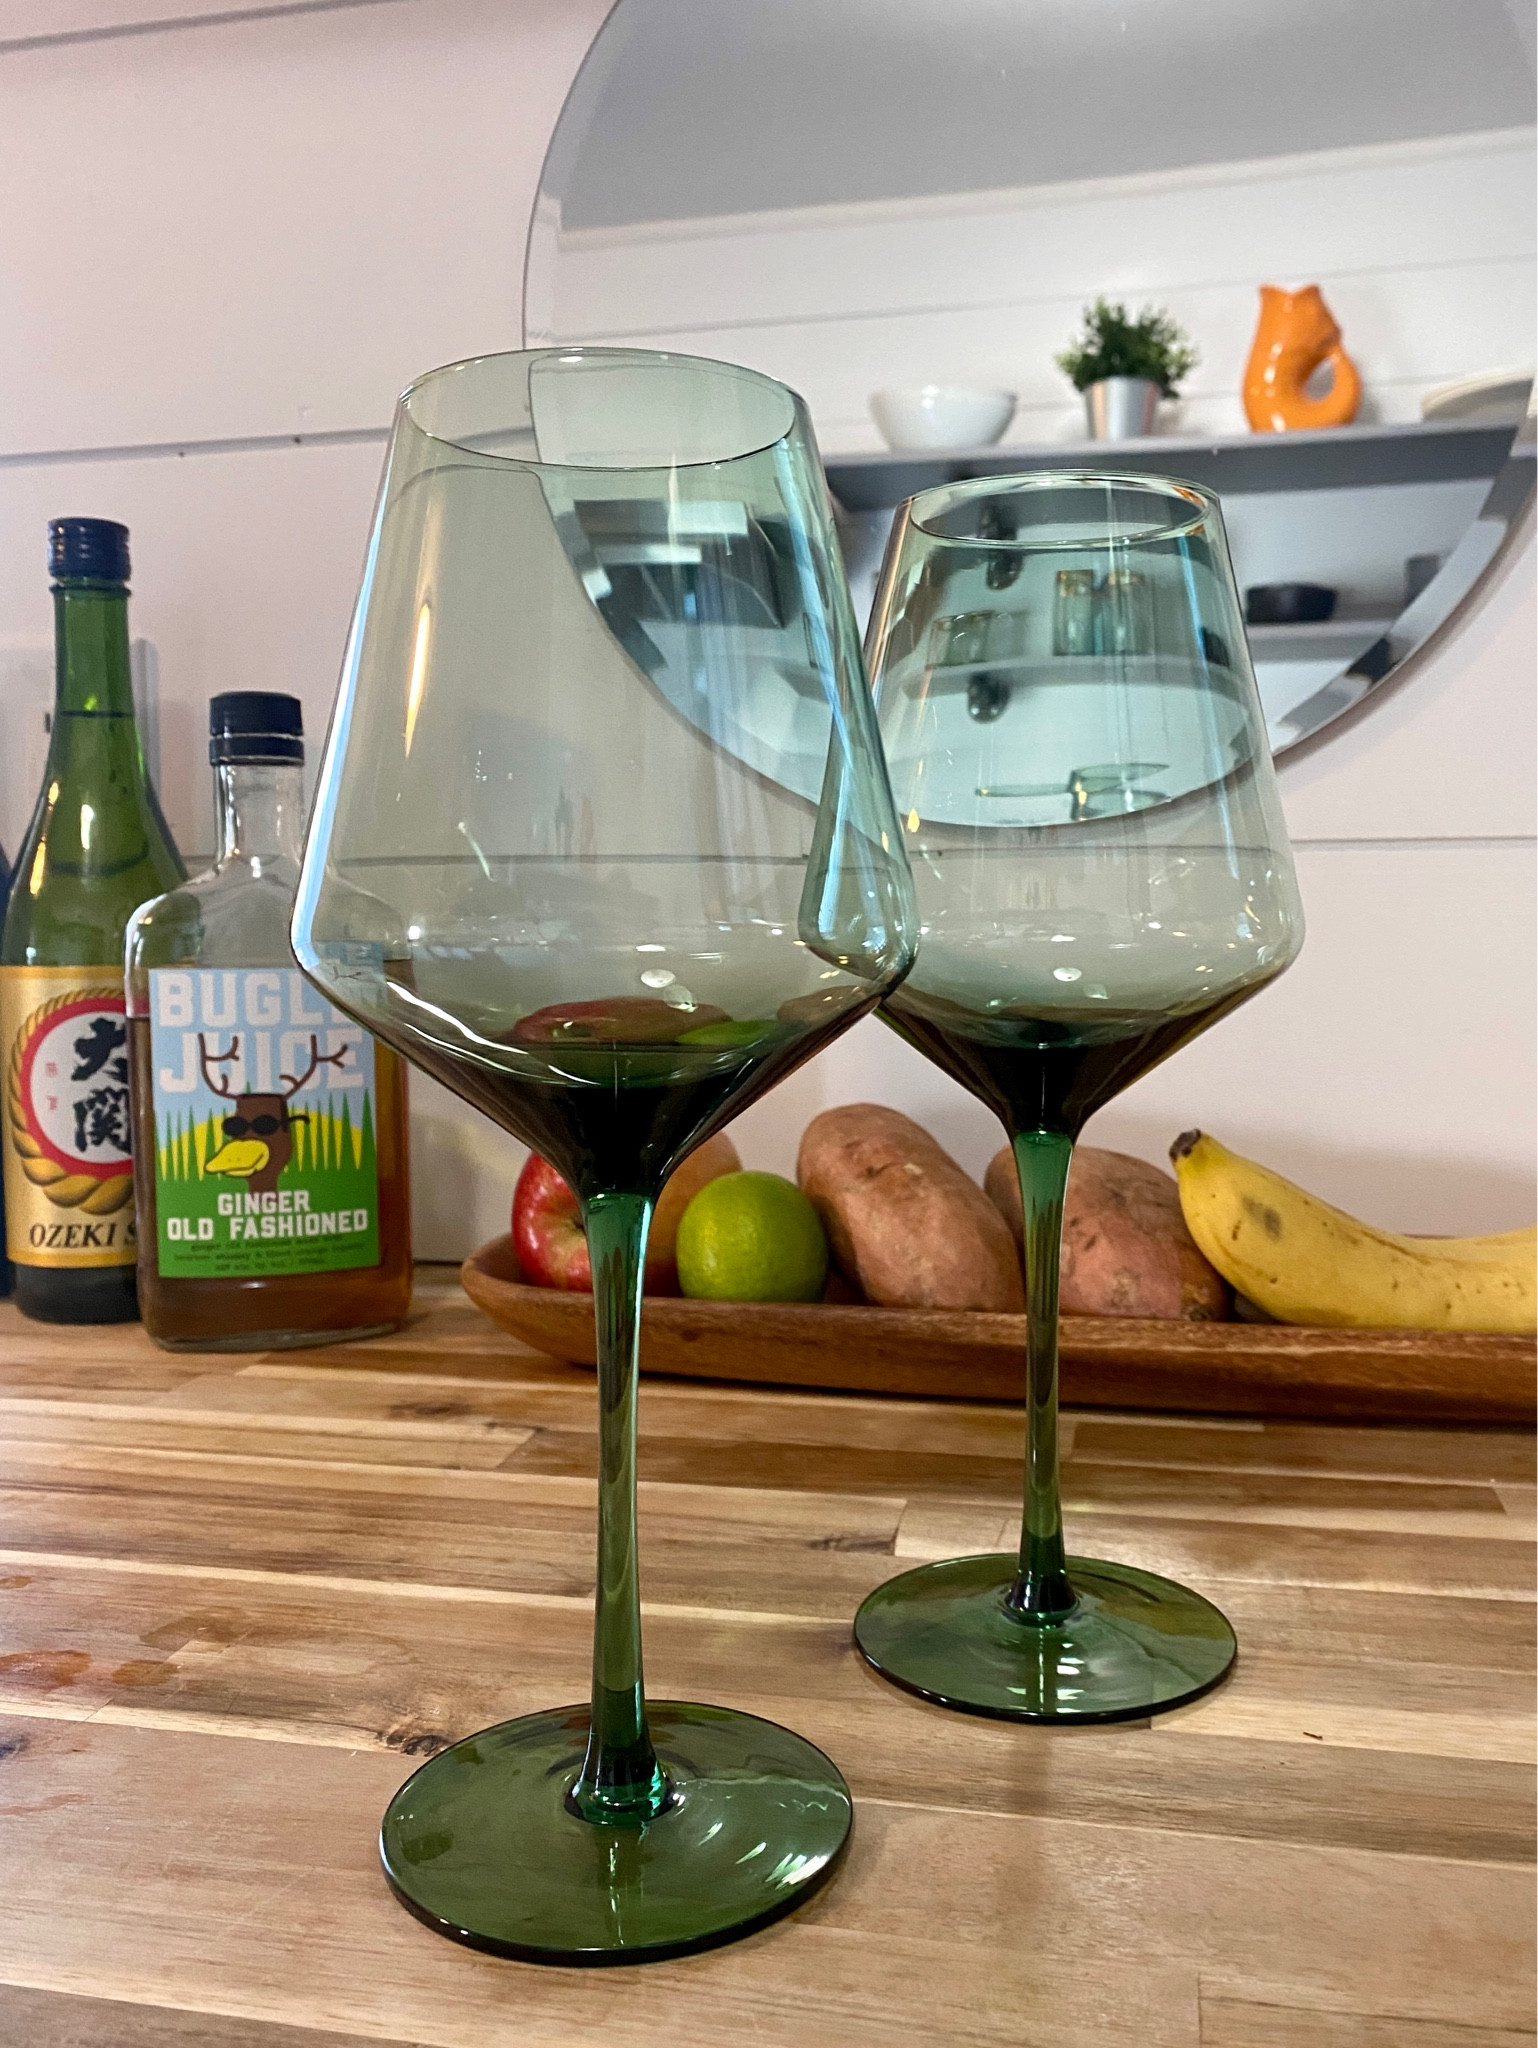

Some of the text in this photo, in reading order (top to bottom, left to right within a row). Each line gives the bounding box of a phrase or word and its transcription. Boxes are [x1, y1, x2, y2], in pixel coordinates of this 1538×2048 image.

[159, 1028, 364, 1093] JUICE
[217, 1190, 311, 1216] GINGER
[29, 1222, 117, 1249] OZEKI
[167, 1217, 214, 1241] OLD
[229, 1209, 368, 1240] FASHIONED
